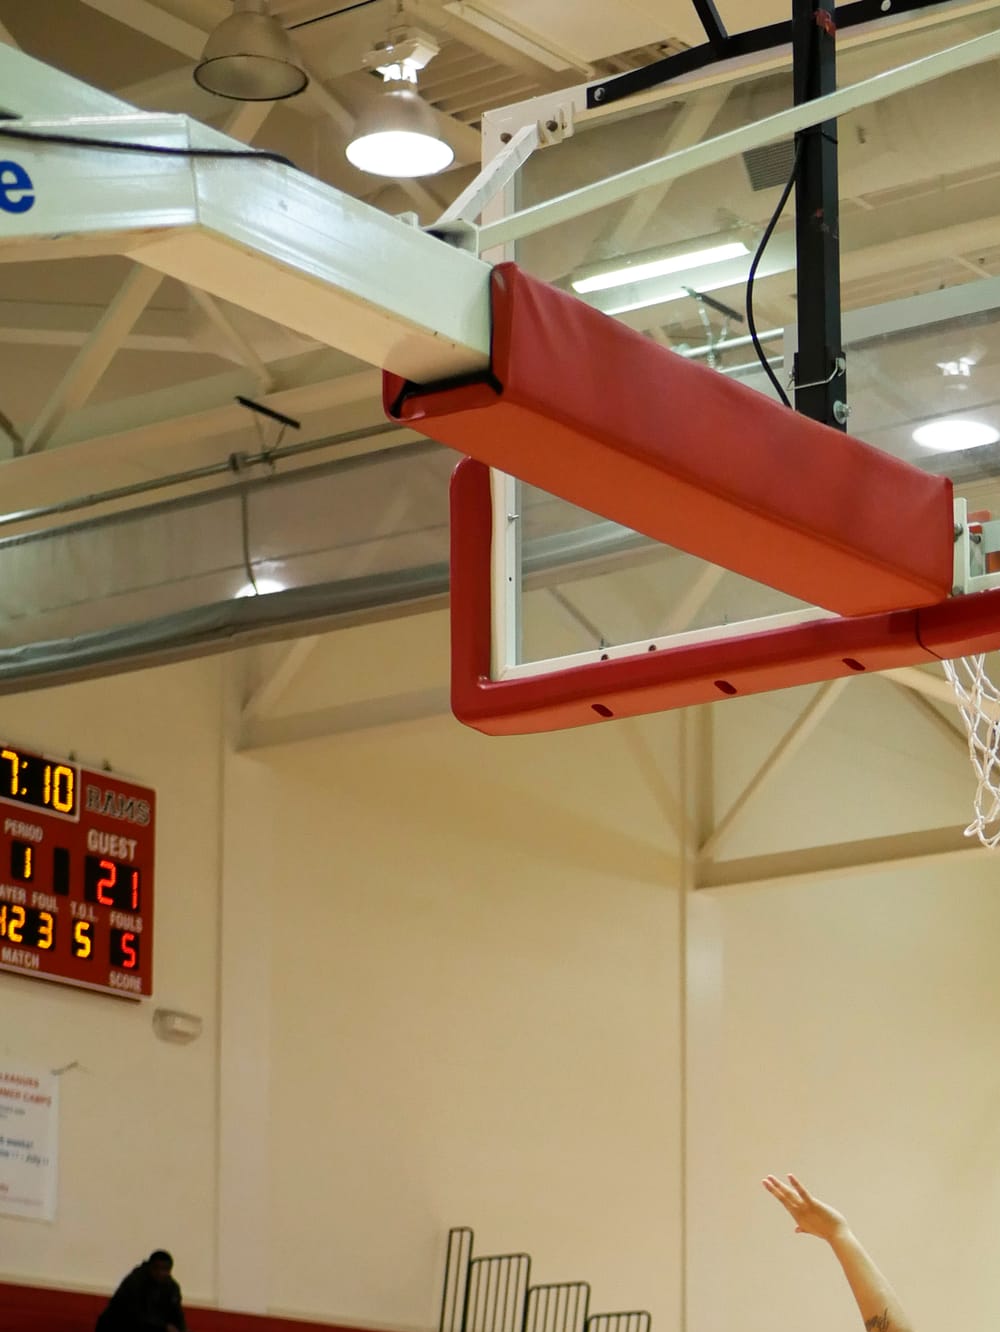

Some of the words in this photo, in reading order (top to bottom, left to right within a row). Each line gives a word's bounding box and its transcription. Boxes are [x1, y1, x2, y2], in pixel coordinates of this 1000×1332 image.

[0, 160, 35, 214] e
[1, 750, 74, 812] 7:10
[86, 784, 151, 826] RAMS
[4, 818, 43, 843] PERIOD
[87, 829, 137, 861] GUEST
[24, 847, 32, 878] 1
[97, 860, 138, 909] 21
[32, 891, 58, 912] FOUL
[110, 910, 142, 933] FOULS
[74, 921, 91, 958] 5
[121, 932, 136, 968] 5
[2, 946, 40, 969] MATCH
[109, 971, 142, 993] SCORE
